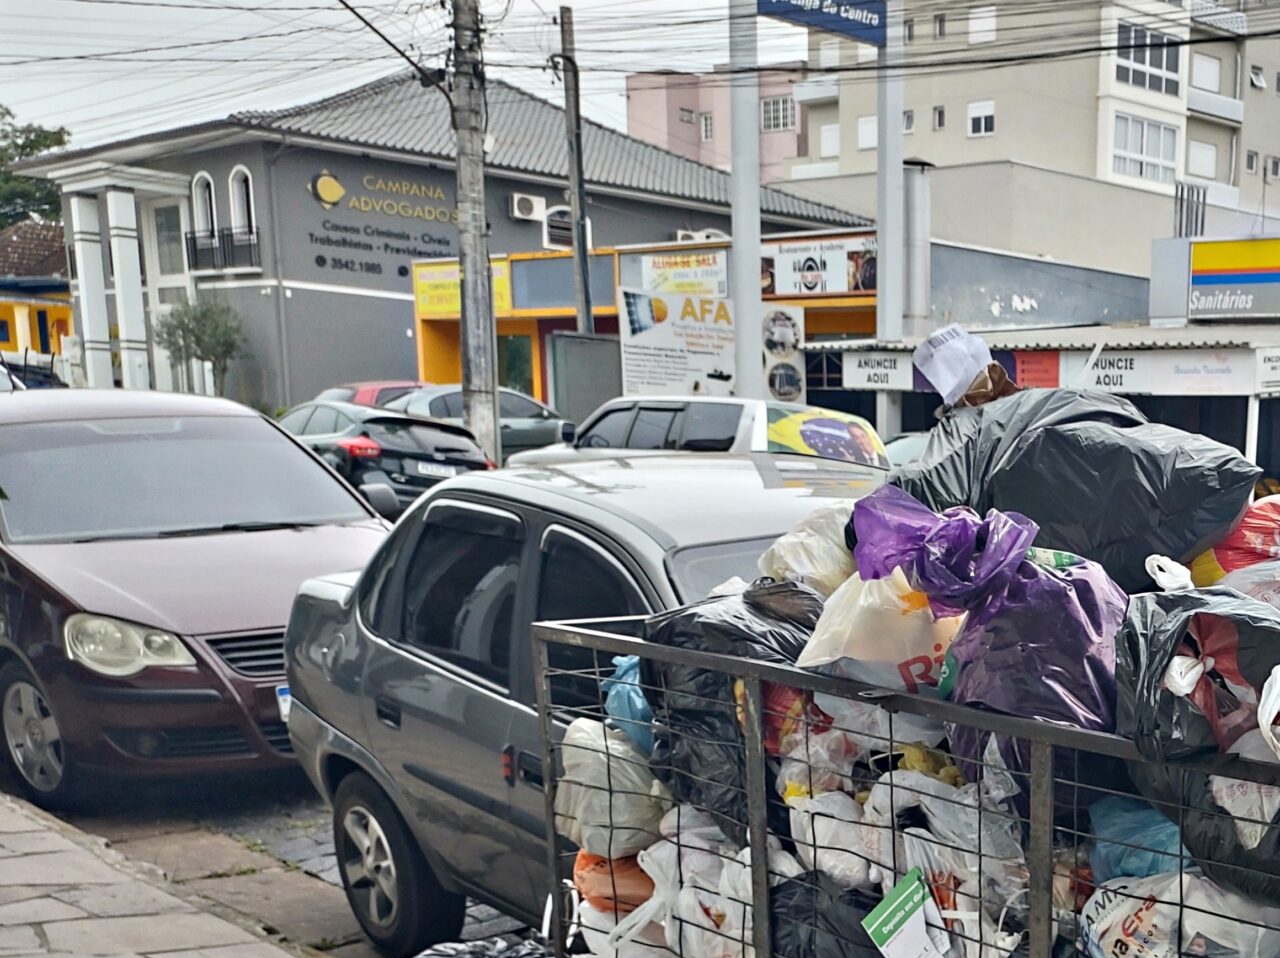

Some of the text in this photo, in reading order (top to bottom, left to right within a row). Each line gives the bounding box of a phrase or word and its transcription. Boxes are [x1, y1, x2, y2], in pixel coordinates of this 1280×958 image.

[822, 0, 837, 14] do
[840, 4, 879, 27] Centro
[363, 174, 445, 200] CAMPANA
[349, 196, 459, 224] ADVOGADOS
[322, 219, 360, 235] Causas
[363, 225, 411, 241] Criminais
[308, 232, 373, 251] Trabalhistas
[1190, 289, 1254, 310] Sanitários
[680, 297, 732, 326] AFA
[857, 358, 898, 371] ANUNCIE
[866, 372, 889, 384] AQUI
[1096, 375, 1124, 387] AQUI
